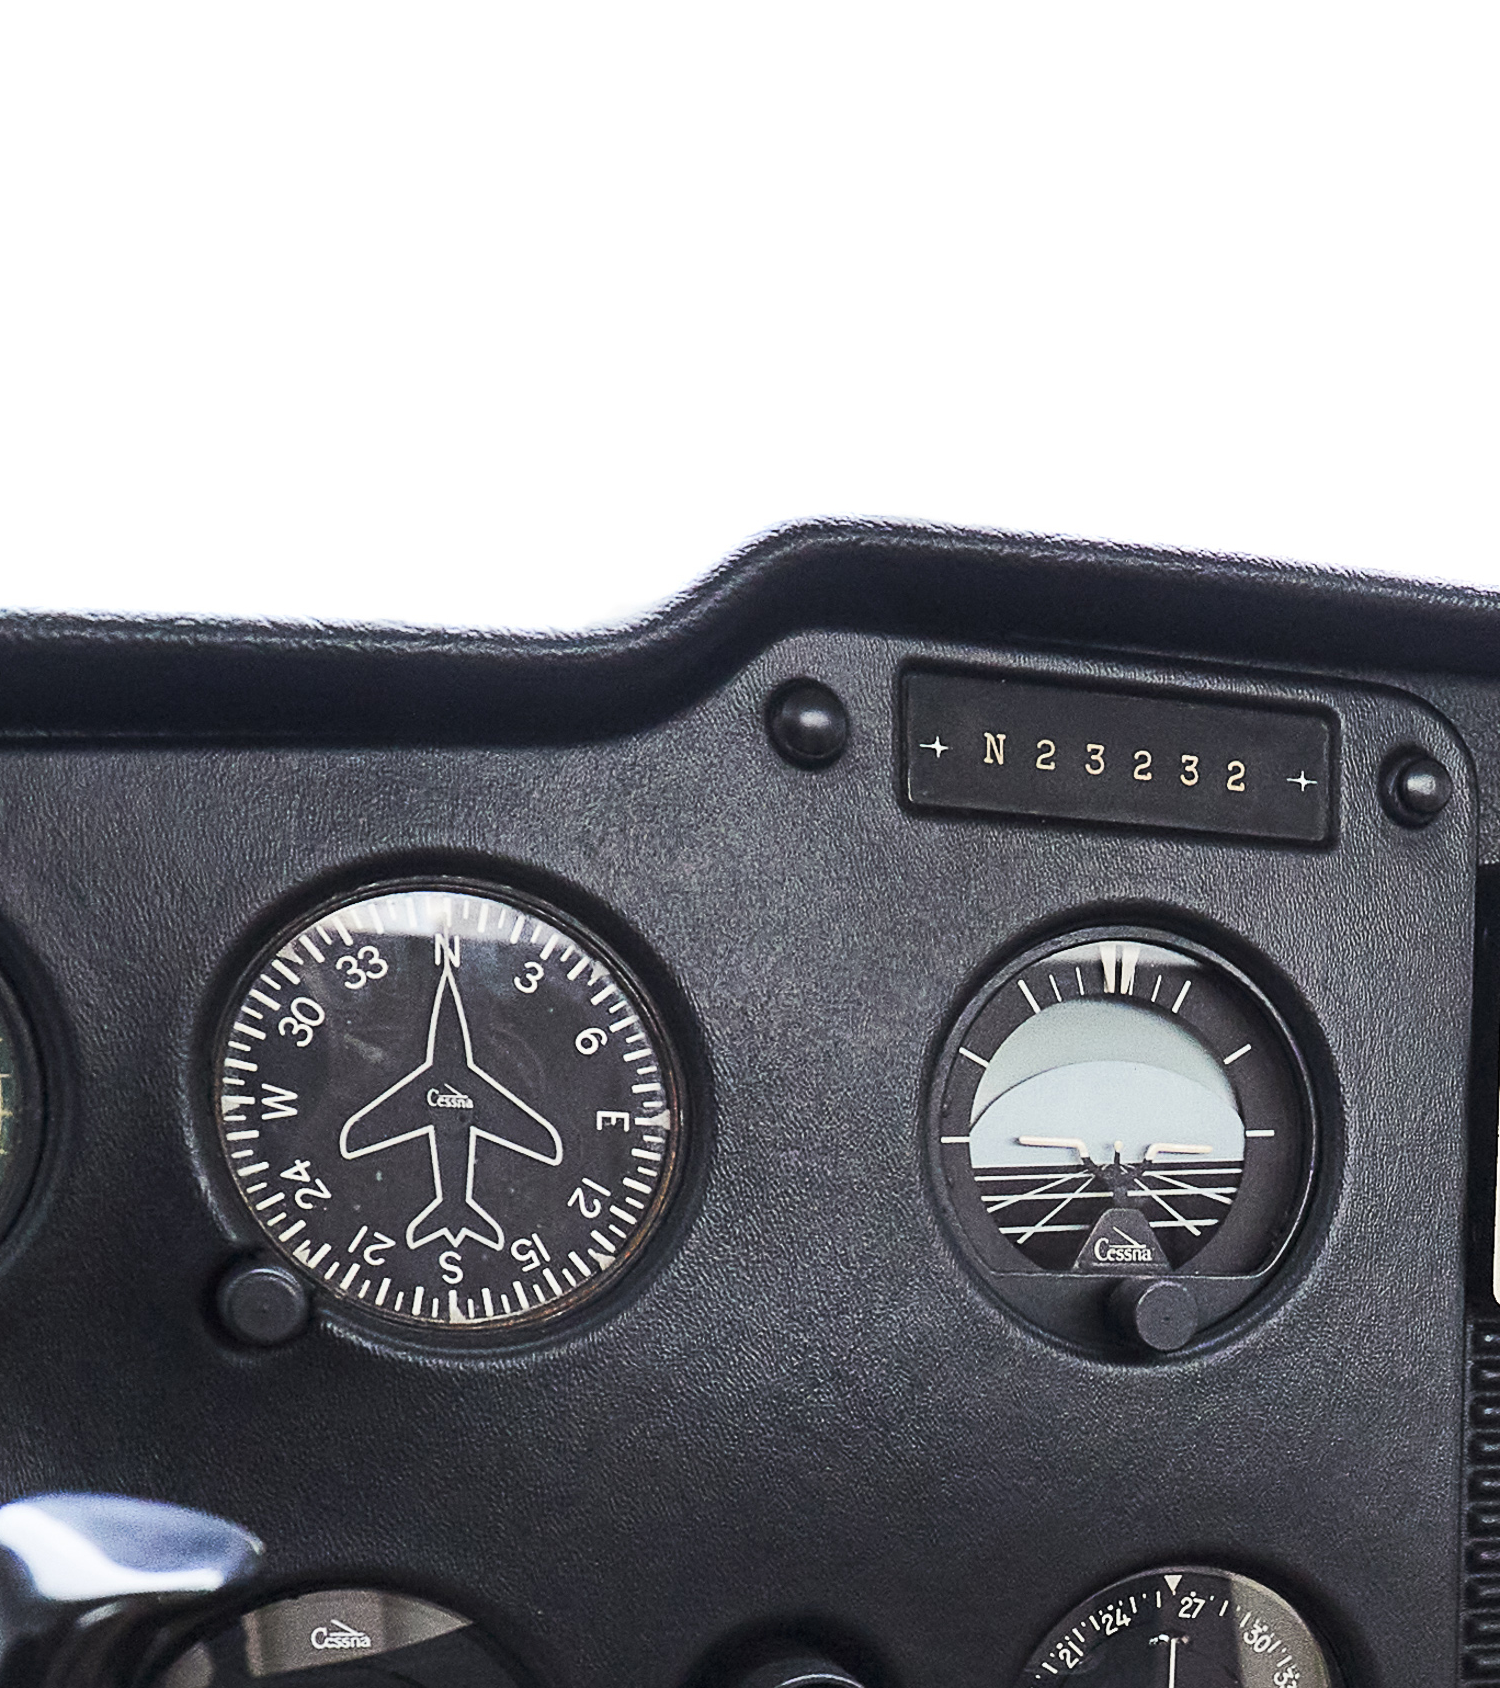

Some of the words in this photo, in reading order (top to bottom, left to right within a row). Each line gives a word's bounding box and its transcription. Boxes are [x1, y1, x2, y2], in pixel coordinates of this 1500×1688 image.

[335, 945, 388, 990] 33
[435, 935, 460, 968] N
[514, 962, 545, 994] 3
[278, 997, 325, 1047] 30
[575, 1027, 608, 1055] 6
[261, 1083, 299, 1120] W
[427, 1087, 474, 1111] Cessna
[596, 1110, 630, 1132] E
[280, 1159, 332, 1210] 24
[568, 1178, 611, 1220] 12
[348, 1226, 396, 1267] 21
[511, 1233, 550, 1273] 15
[1094, 1237, 1152, 1264] Cessna
[439, 1252, 464, 1284] S
[1101, 1608, 1132, 1637] 24
[1178, 1596, 1206, 1619] 27
[311, 1626, 371, 1650] Cessna
[1243, 1625, 1272, 1654] 30
[1058, 1640, 1084, 1669] 21
